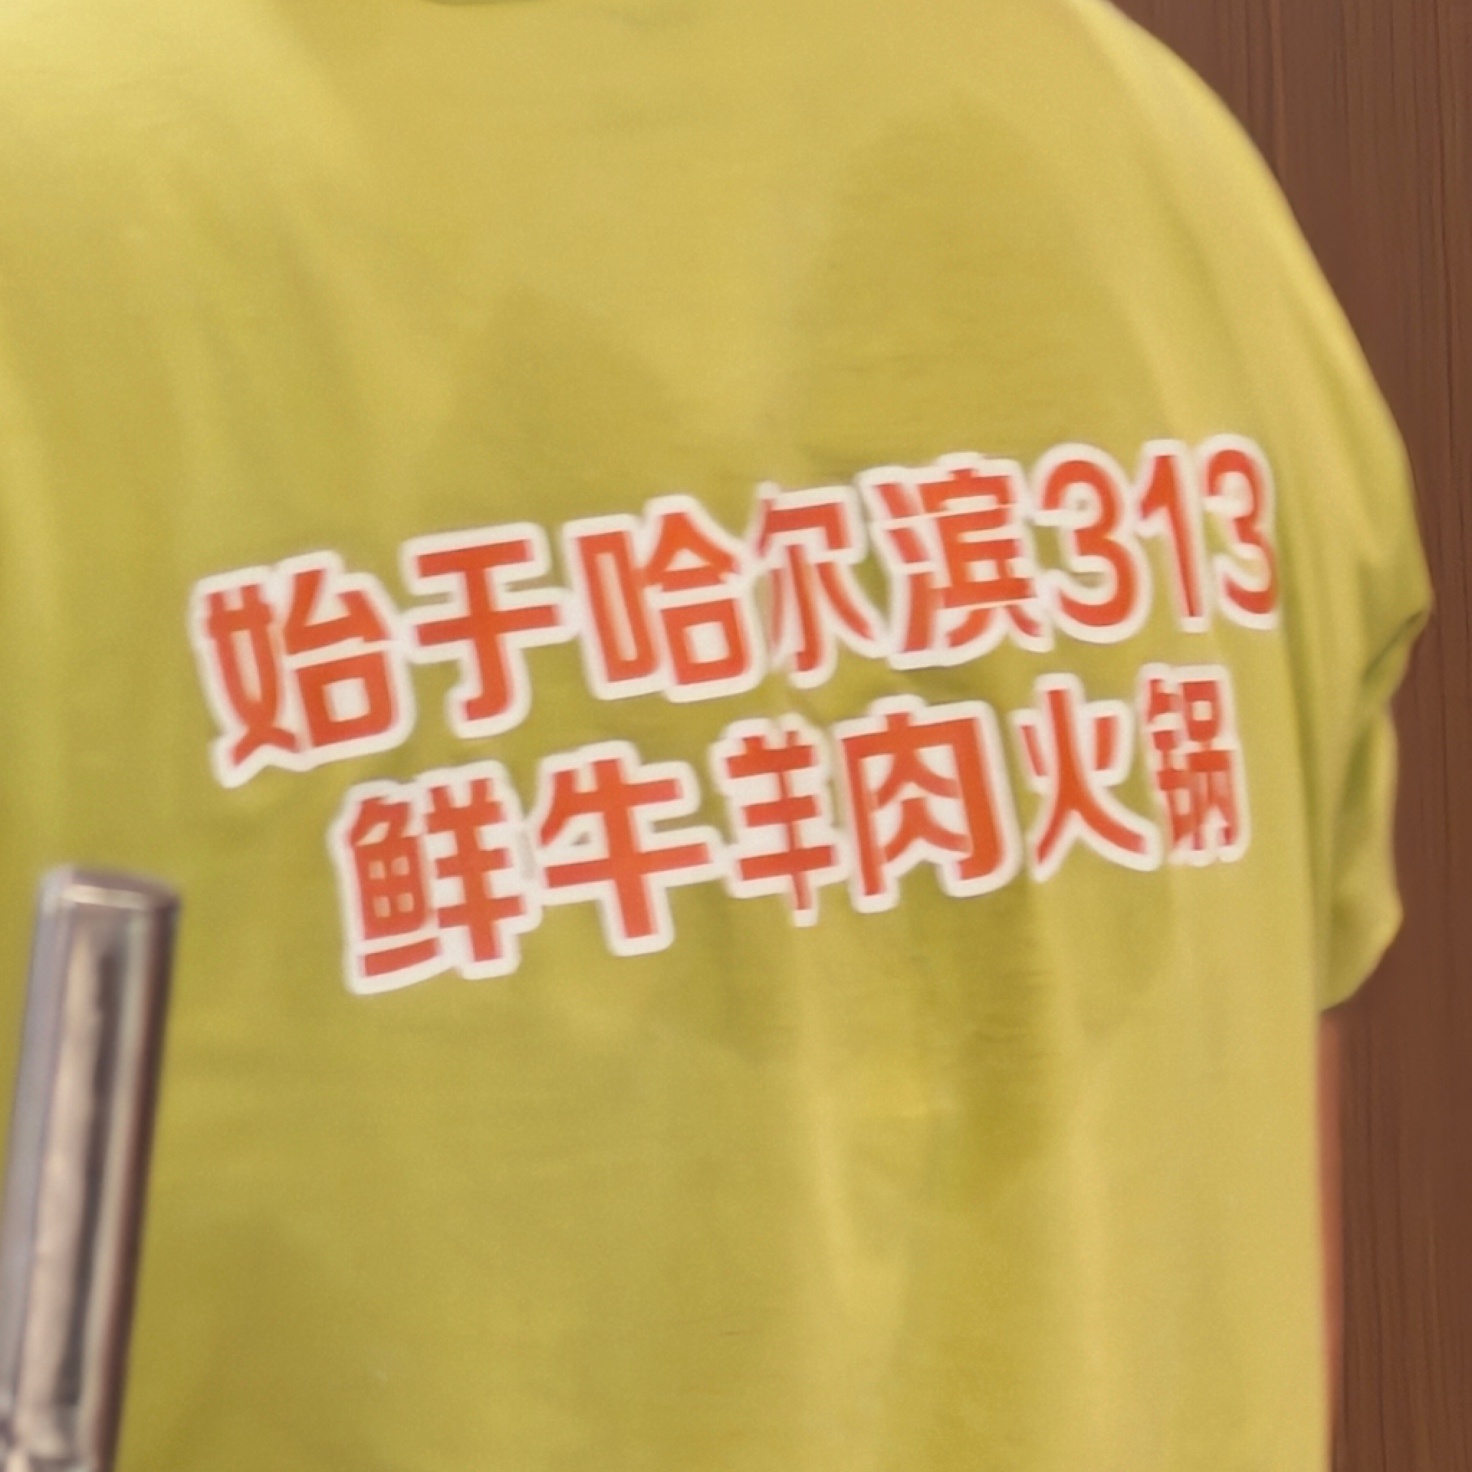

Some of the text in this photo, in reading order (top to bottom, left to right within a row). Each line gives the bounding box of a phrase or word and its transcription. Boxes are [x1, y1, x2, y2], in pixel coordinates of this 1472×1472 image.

[196, 438, 1278, 778] 始于哈尔滨313
[331, 668, 1246, 988] 鲜牛羊肉火锅
